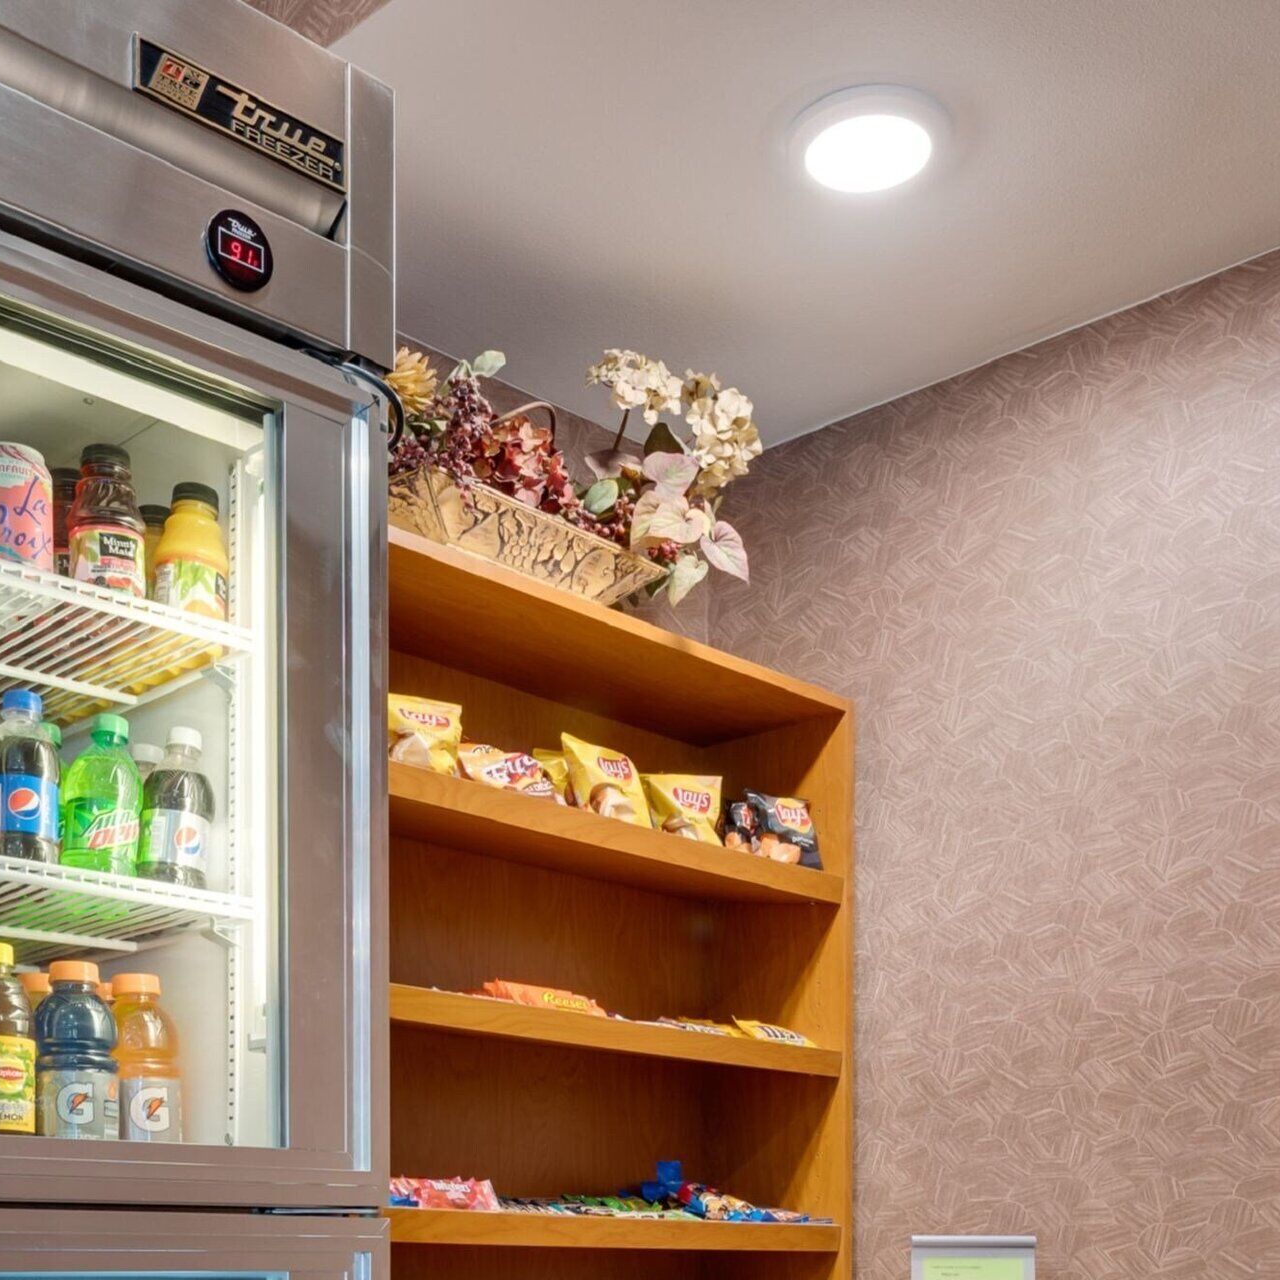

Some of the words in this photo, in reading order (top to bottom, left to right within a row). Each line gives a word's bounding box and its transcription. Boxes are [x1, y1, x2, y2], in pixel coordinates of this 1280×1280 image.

[230, 118, 334, 180] FREEZER
[13, 475, 47, 526] La
[56, 1081, 95, 1126] G
[129, 1086, 170, 1133] G
